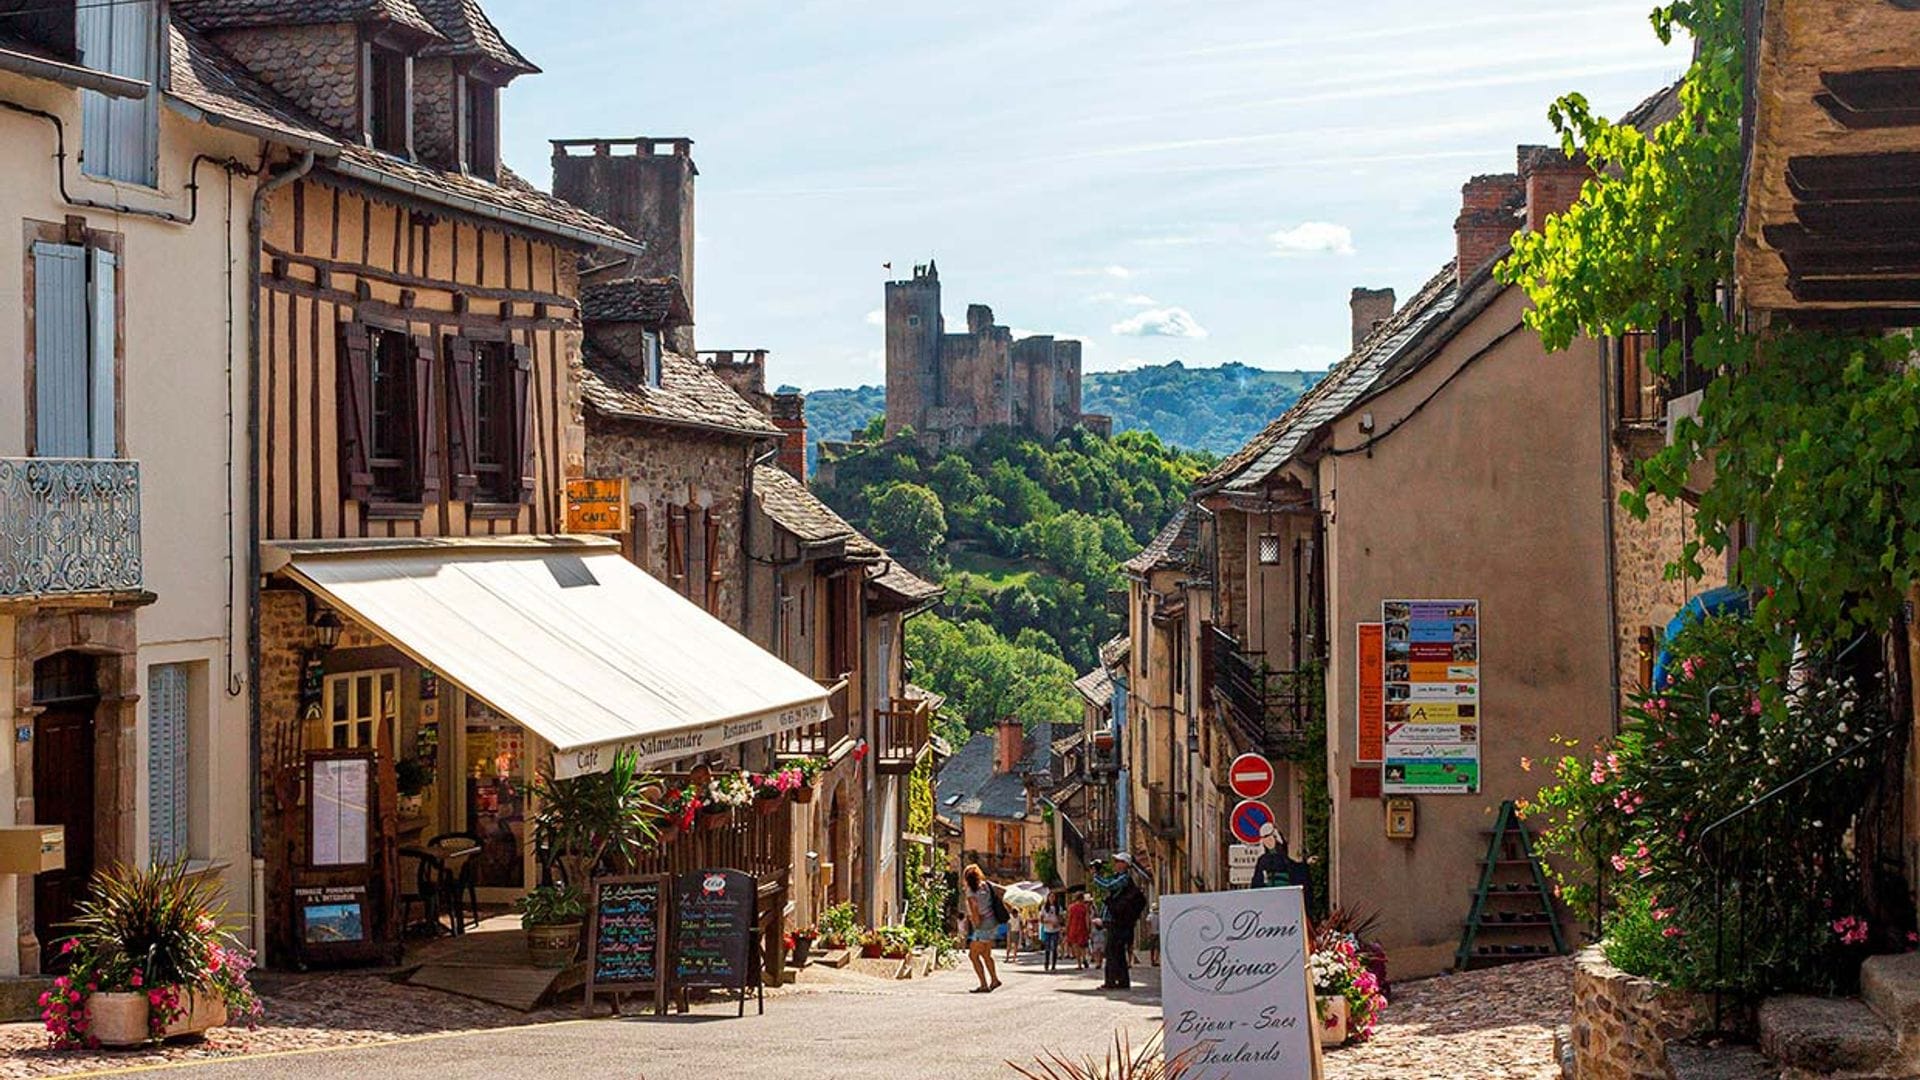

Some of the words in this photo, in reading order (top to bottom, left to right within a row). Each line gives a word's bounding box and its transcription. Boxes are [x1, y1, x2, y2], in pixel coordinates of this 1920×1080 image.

[577, 747, 598, 769] Café
[639, 733, 703, 757] Salamandre
[1226, 910, 1298, 941] Domi
[1188, 946, 1277, 992] Bijoux
[1176, 1010, 1237, 1041] Bijoux
[1254, 1006, 1297, 1030] Sacs
